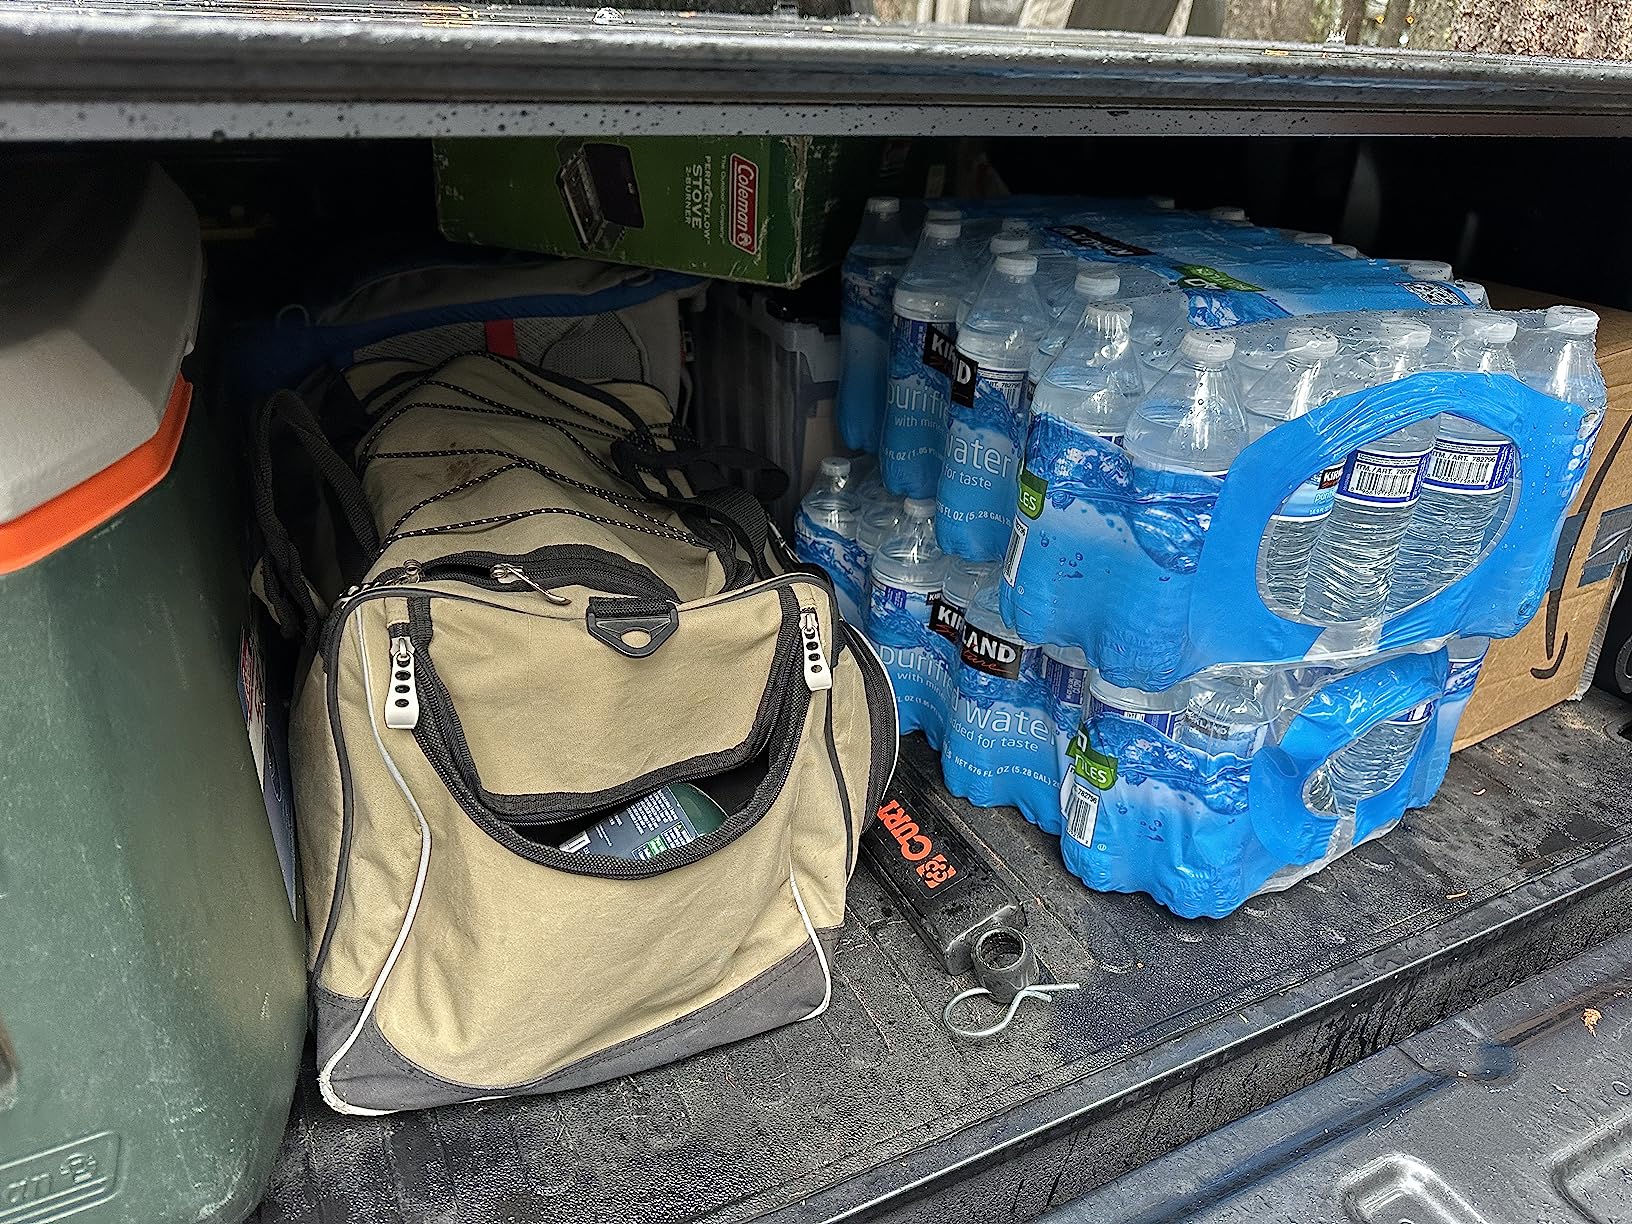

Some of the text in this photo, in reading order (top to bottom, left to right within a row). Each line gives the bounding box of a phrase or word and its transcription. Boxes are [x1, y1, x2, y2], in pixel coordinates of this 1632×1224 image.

[691, 164, 703, 229] STOVE
[736, 164, 755, 231] Coleman
[895, 415, 917, 427] with
[959, 472, 992, 491] taste
[945, 507, 952, 518] FL
[953, 511, 965, 522] OZ
[965, 510, 989, 523] (5.28
[897, 671, 924, 684] with
[977, 733, 996, 749] for
[1001, 736, 1039, 752] taste
[955, 756, 968, 768] NET
[968, 764, 982, 776] 676
[983, 770, 993, 778] FL
[996, 765, 1010, 775] OZ
[1011, 765, 1033, 777] (5.28
[1033, 771, 1051, 786] GAL)
[877, 799, 933, 861] CURT
